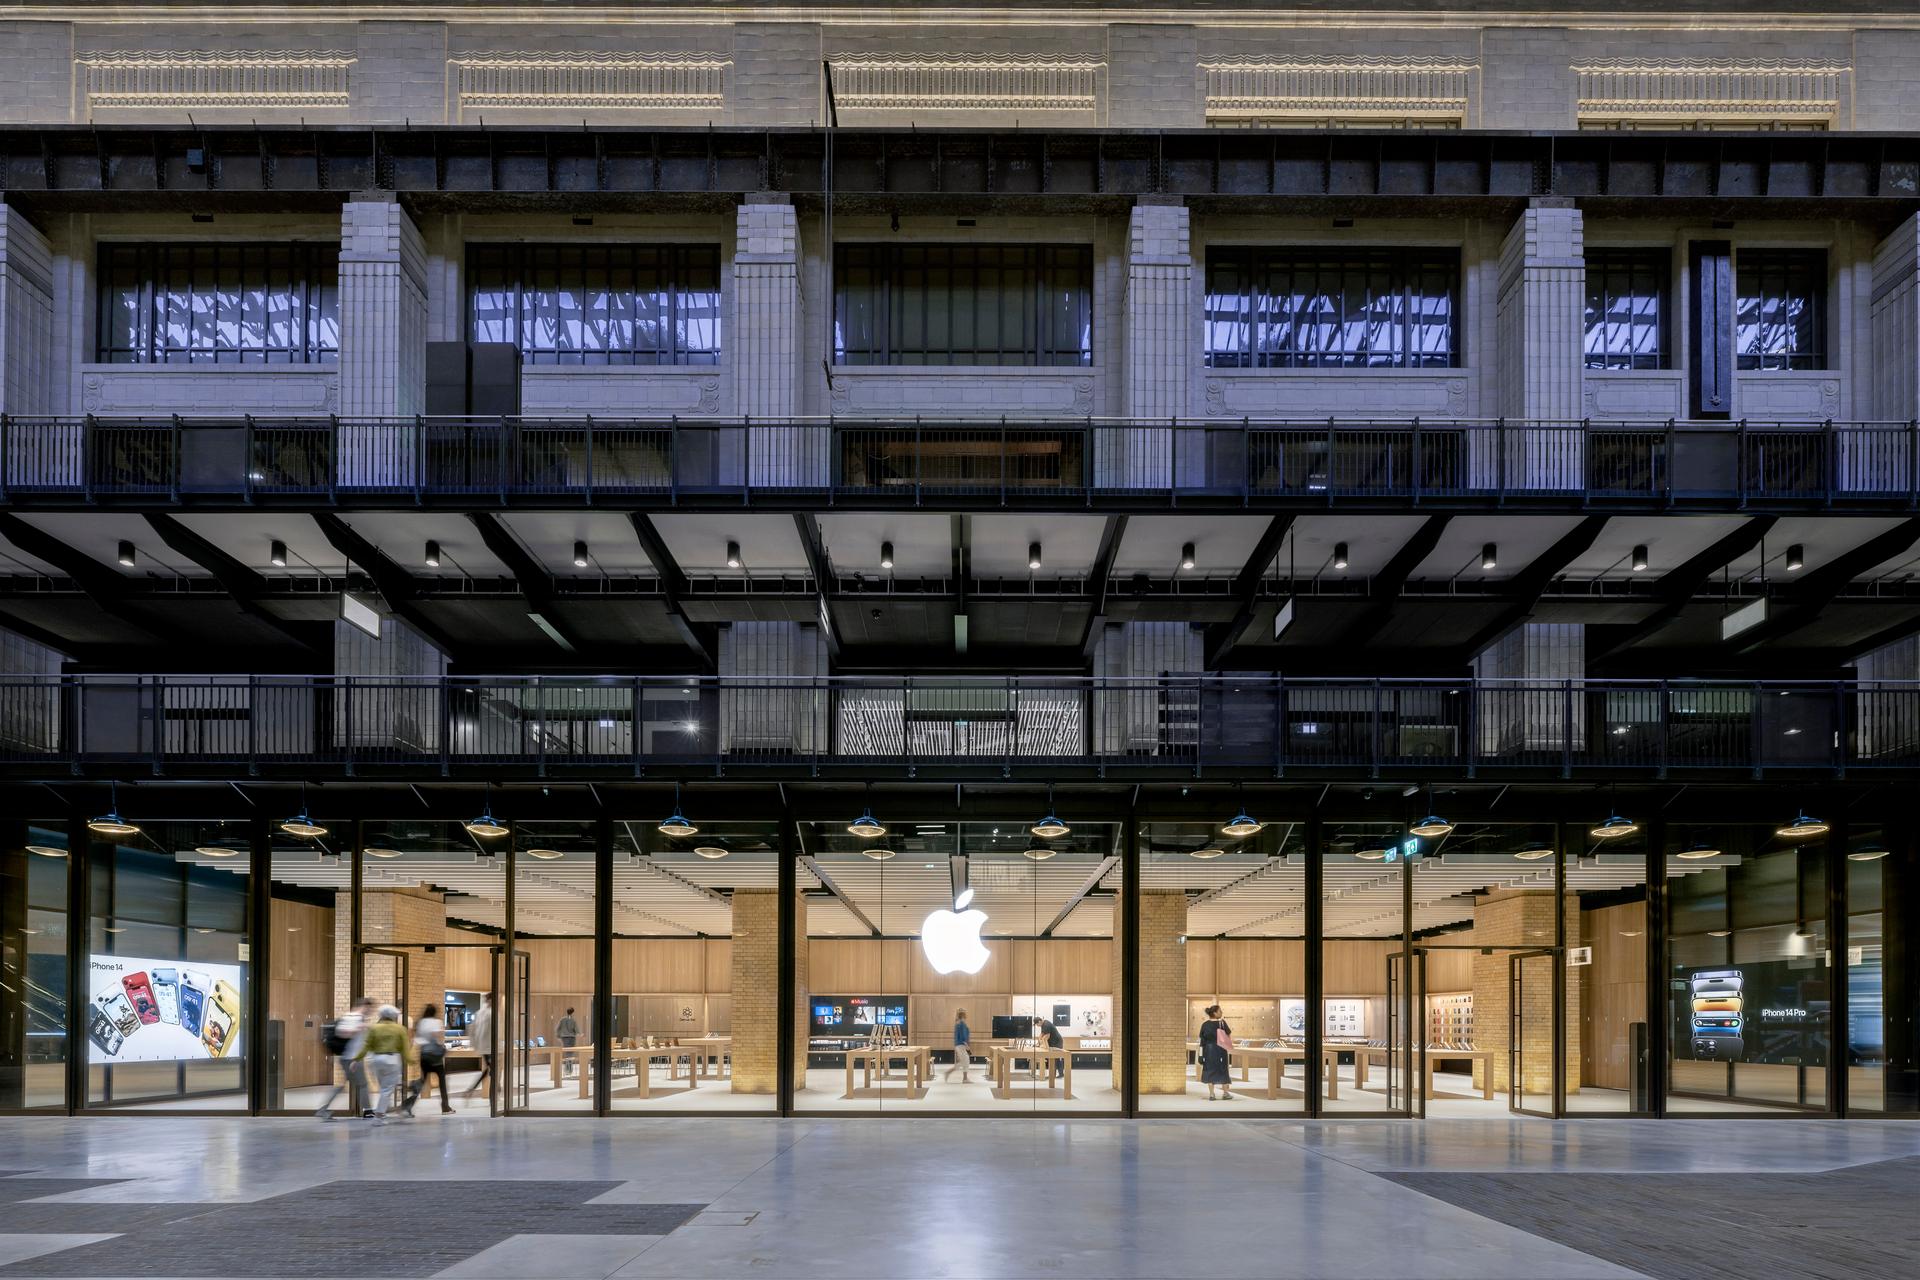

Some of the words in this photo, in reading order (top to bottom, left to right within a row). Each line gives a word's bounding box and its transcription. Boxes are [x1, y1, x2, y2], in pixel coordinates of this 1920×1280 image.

[90, 962, 115, 970] iPhone
[1785, 1008, 1793, 1016] 14
[1794, 1008, 1806, 1016] Pro
